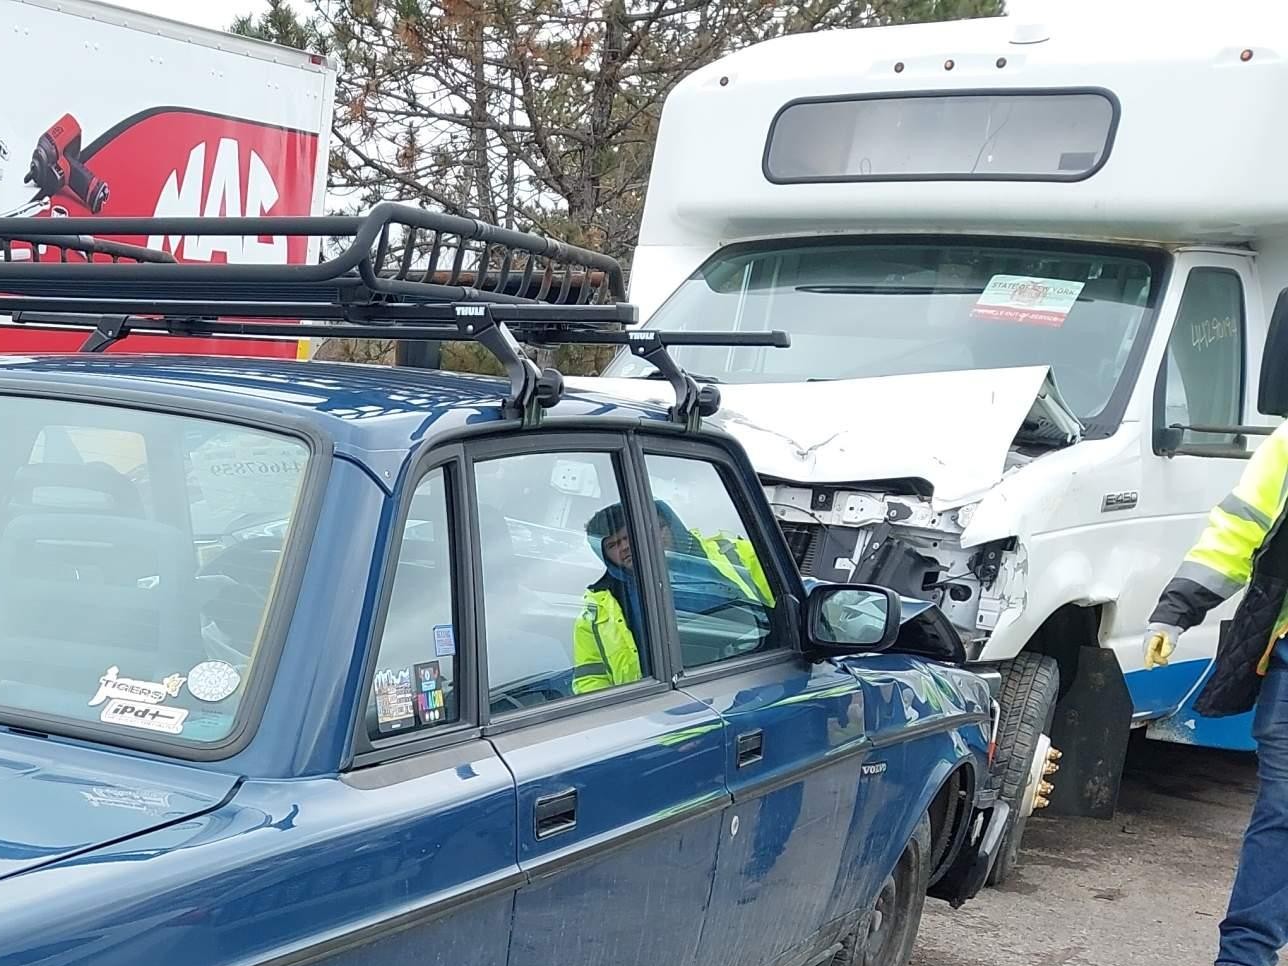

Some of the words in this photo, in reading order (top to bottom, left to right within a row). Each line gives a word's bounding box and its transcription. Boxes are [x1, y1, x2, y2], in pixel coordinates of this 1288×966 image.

[146, 137, 288, 265] MAC
[991, 281, 1018, 290] STATE
[455, 306, 486, 316] THULE
[629, 331, 656, 340] THULE
[102, 678, 164, 700] TIGERS
[862, 762, 887, 775] VOLVO
